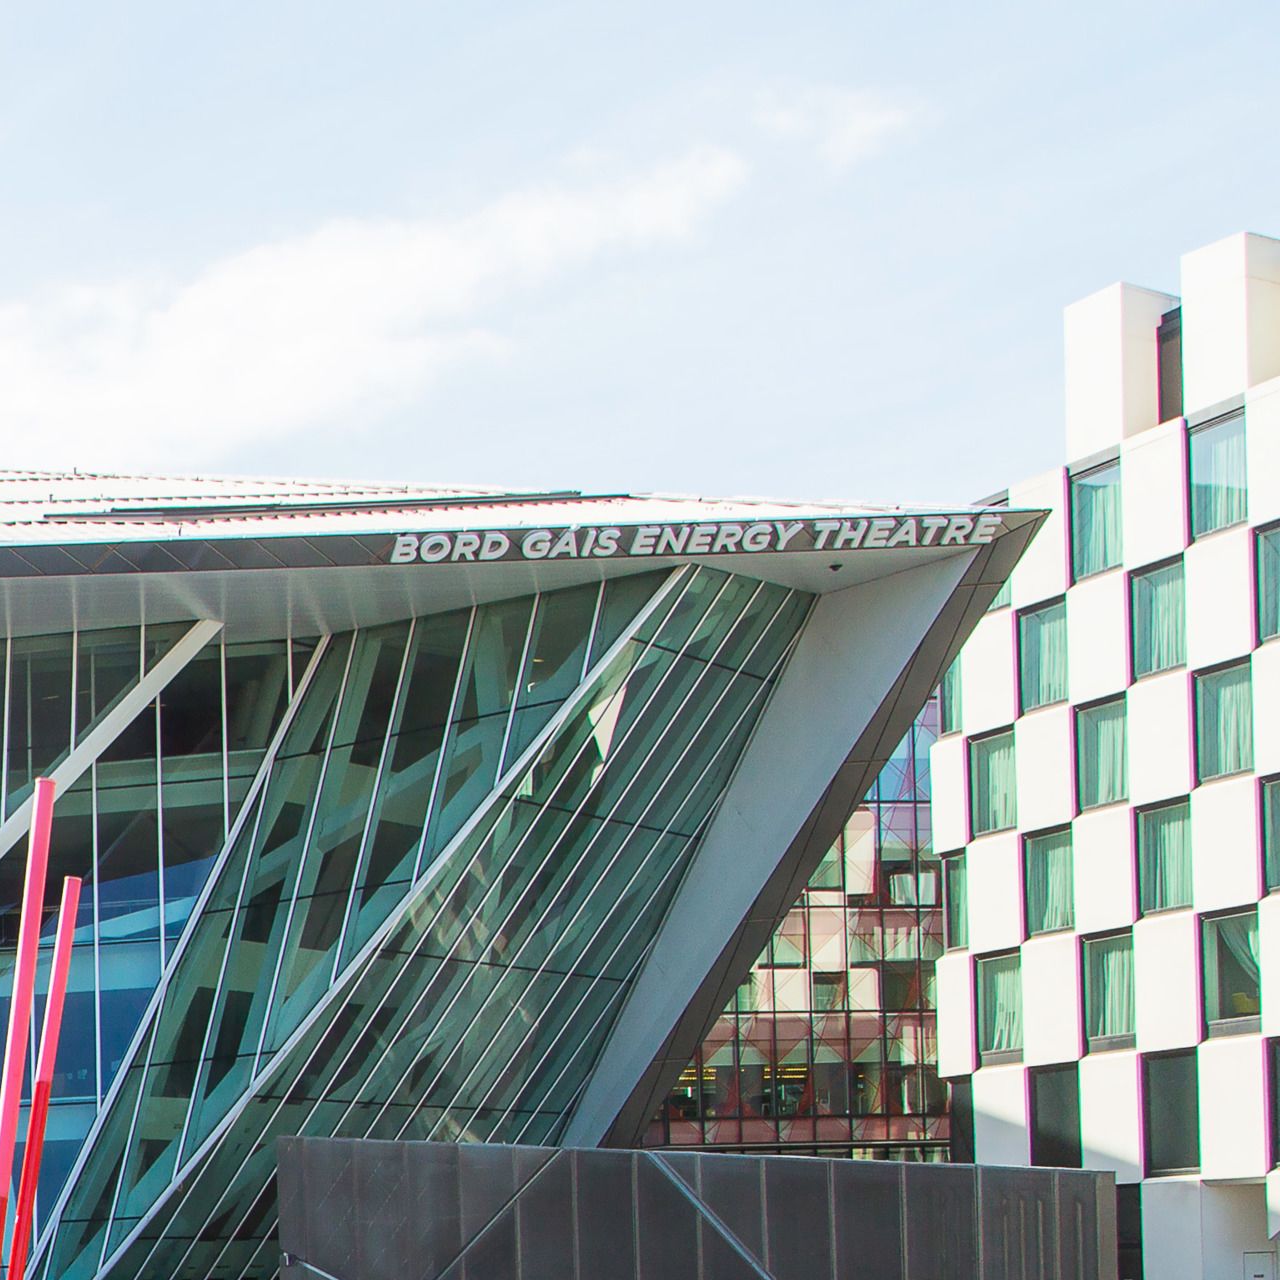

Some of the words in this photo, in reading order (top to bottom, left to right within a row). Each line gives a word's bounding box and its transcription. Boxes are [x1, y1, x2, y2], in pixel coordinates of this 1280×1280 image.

[390, 532, 510, 564] BORD
[630, 520, 804, 556] ENERGY
[814, 514, 1002, 550] THEATRE
